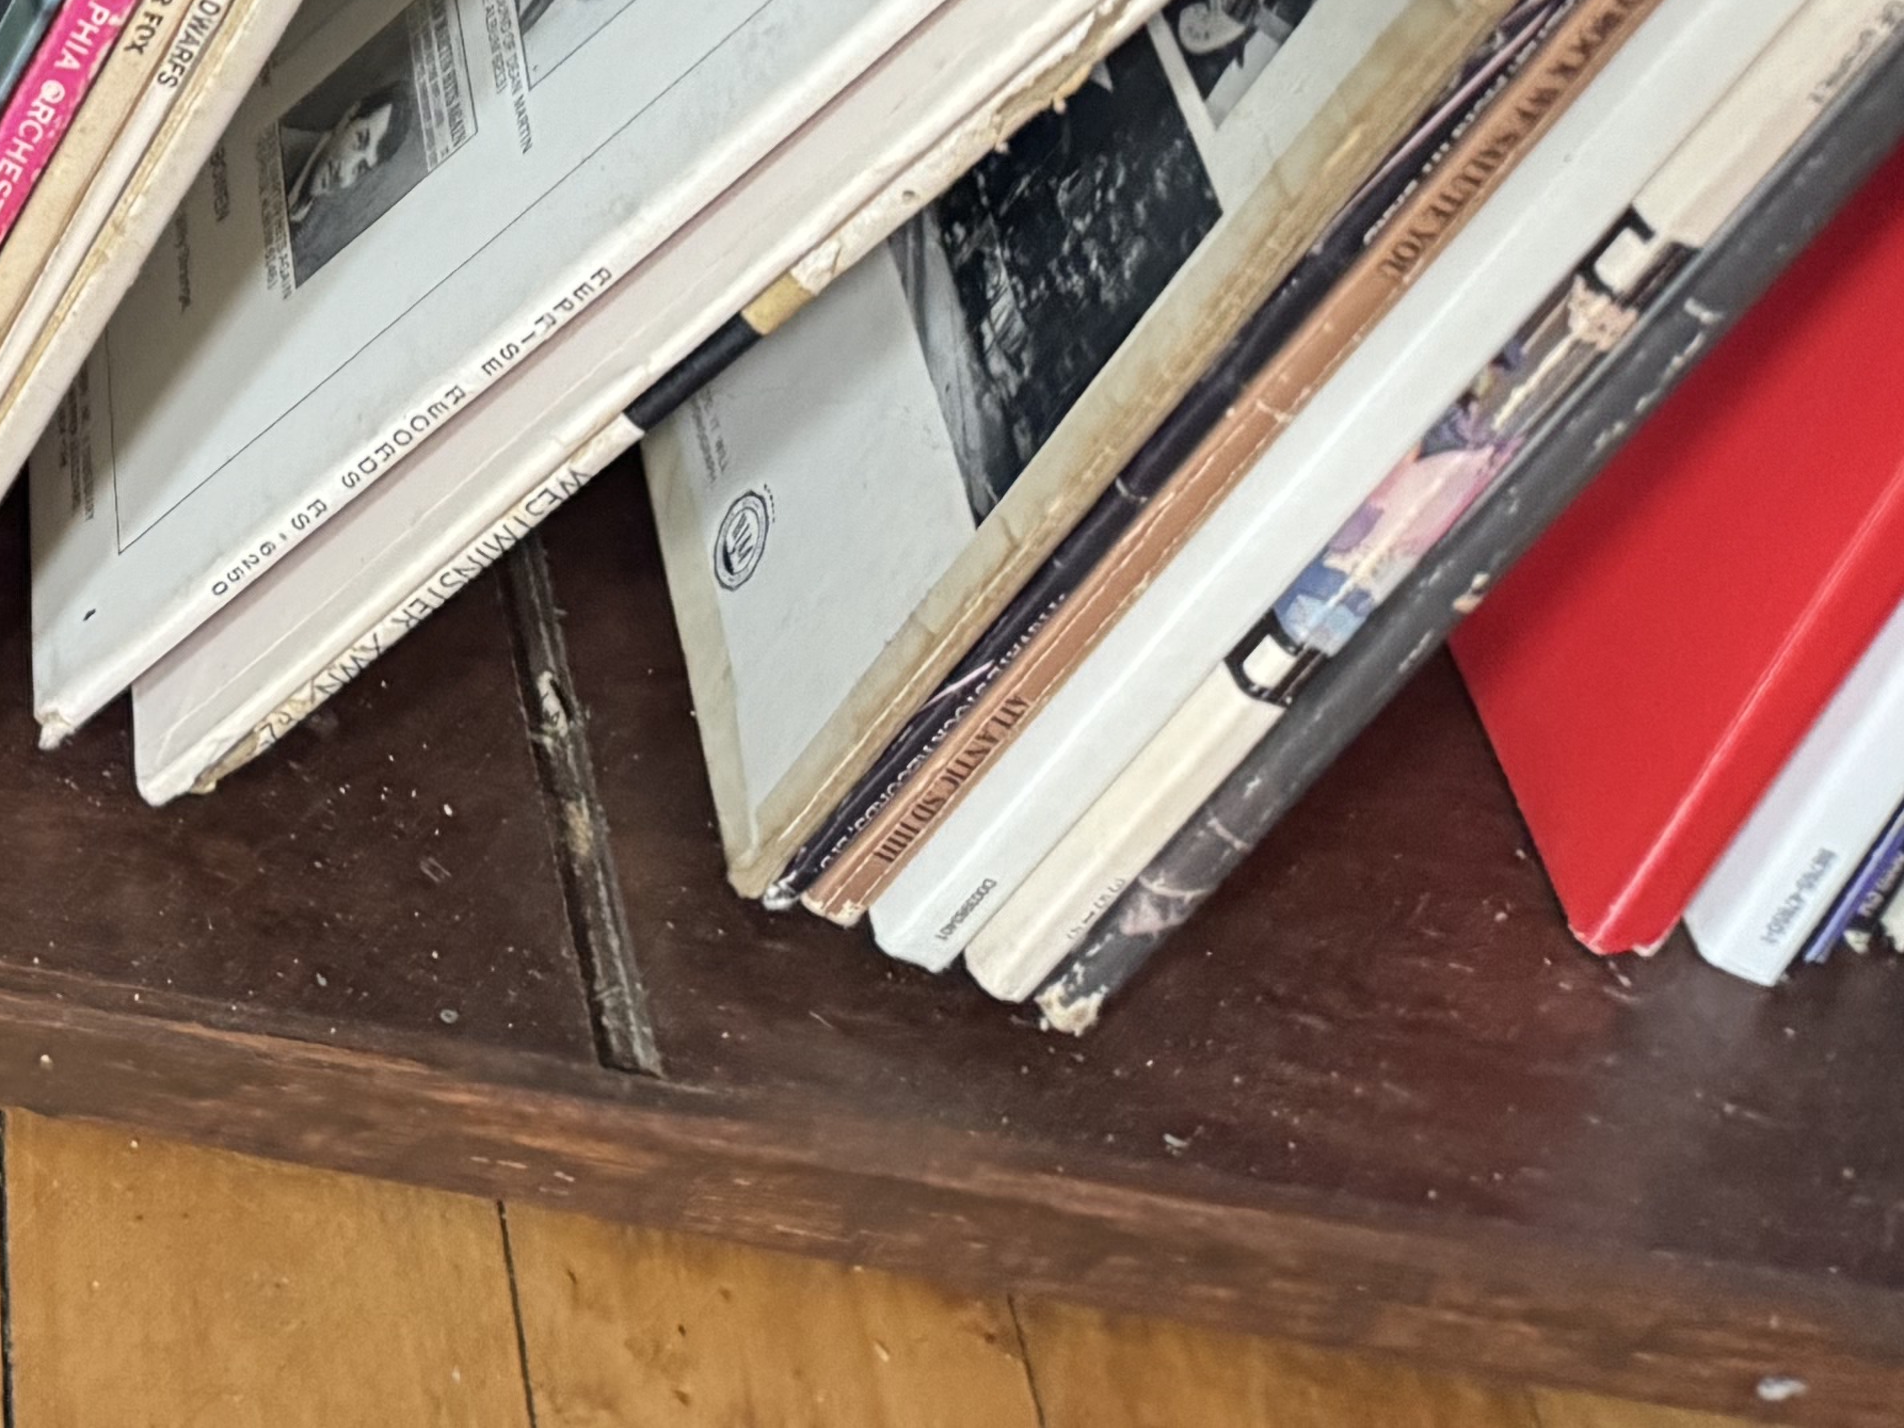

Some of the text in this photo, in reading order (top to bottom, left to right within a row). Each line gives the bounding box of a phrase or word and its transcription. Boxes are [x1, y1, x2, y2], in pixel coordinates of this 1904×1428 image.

[505, 91, 541, 157] MARTIN
[1425, 120, 1522, 226] SALUTE
[1374, 216, 1439, 285] YOU
[207, 262, 613, 601] REPRISE RECORDS RS-6250
[938, 689, 1031, 795] ATLANTIC
[909, 788, 946, 827] SD
